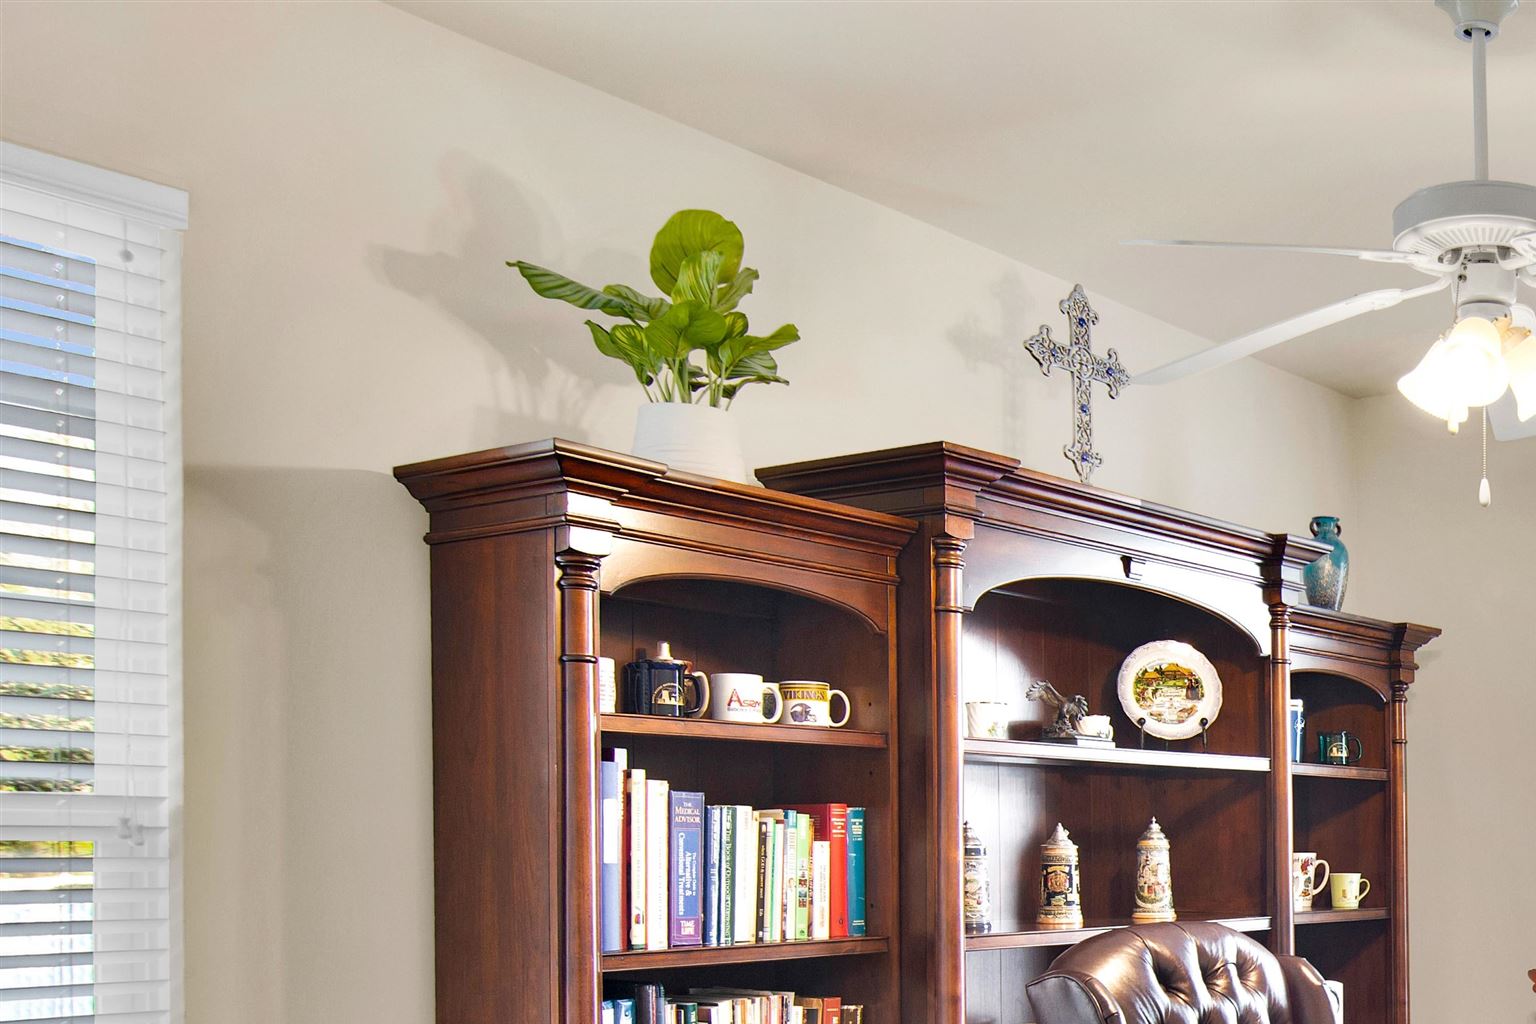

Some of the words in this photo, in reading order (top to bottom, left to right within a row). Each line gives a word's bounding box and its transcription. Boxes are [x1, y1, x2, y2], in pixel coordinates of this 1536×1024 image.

[784, 690, 825, 700] VIKINGS
[675, 806, 700, 815] MEDICAL
[675, 815, 701, 824] ADVISOR
[681, 927, 695, 935] LIFE
